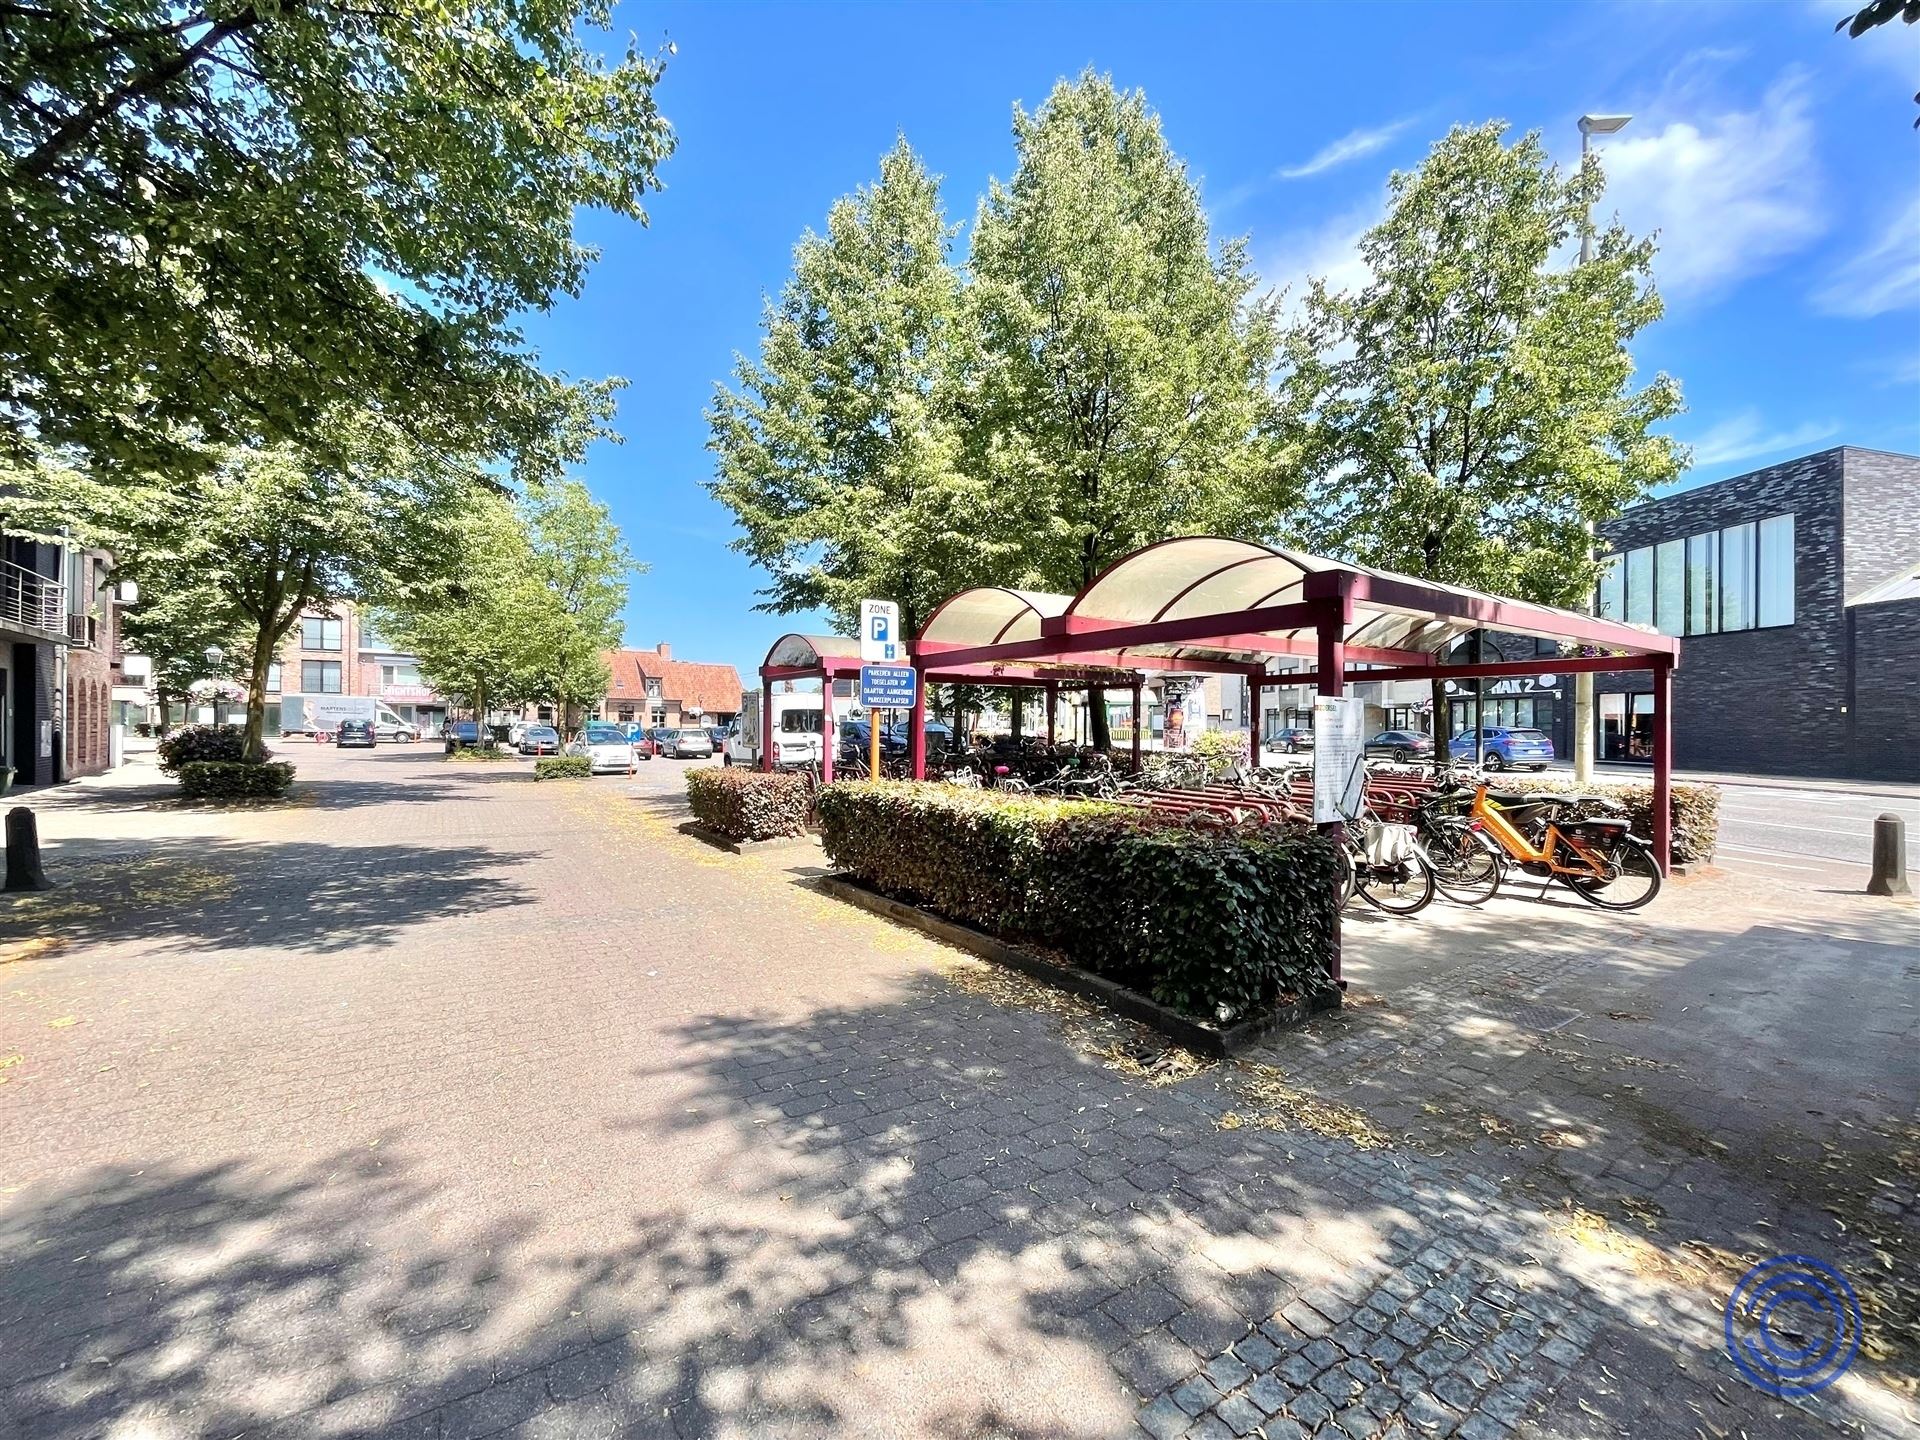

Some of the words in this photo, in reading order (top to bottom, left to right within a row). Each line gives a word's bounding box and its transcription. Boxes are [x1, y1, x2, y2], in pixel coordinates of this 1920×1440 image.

[869, 604, 891, 614] ZONE
[873, 619, 887, 639] P
[627, 723, 639, 738] P
